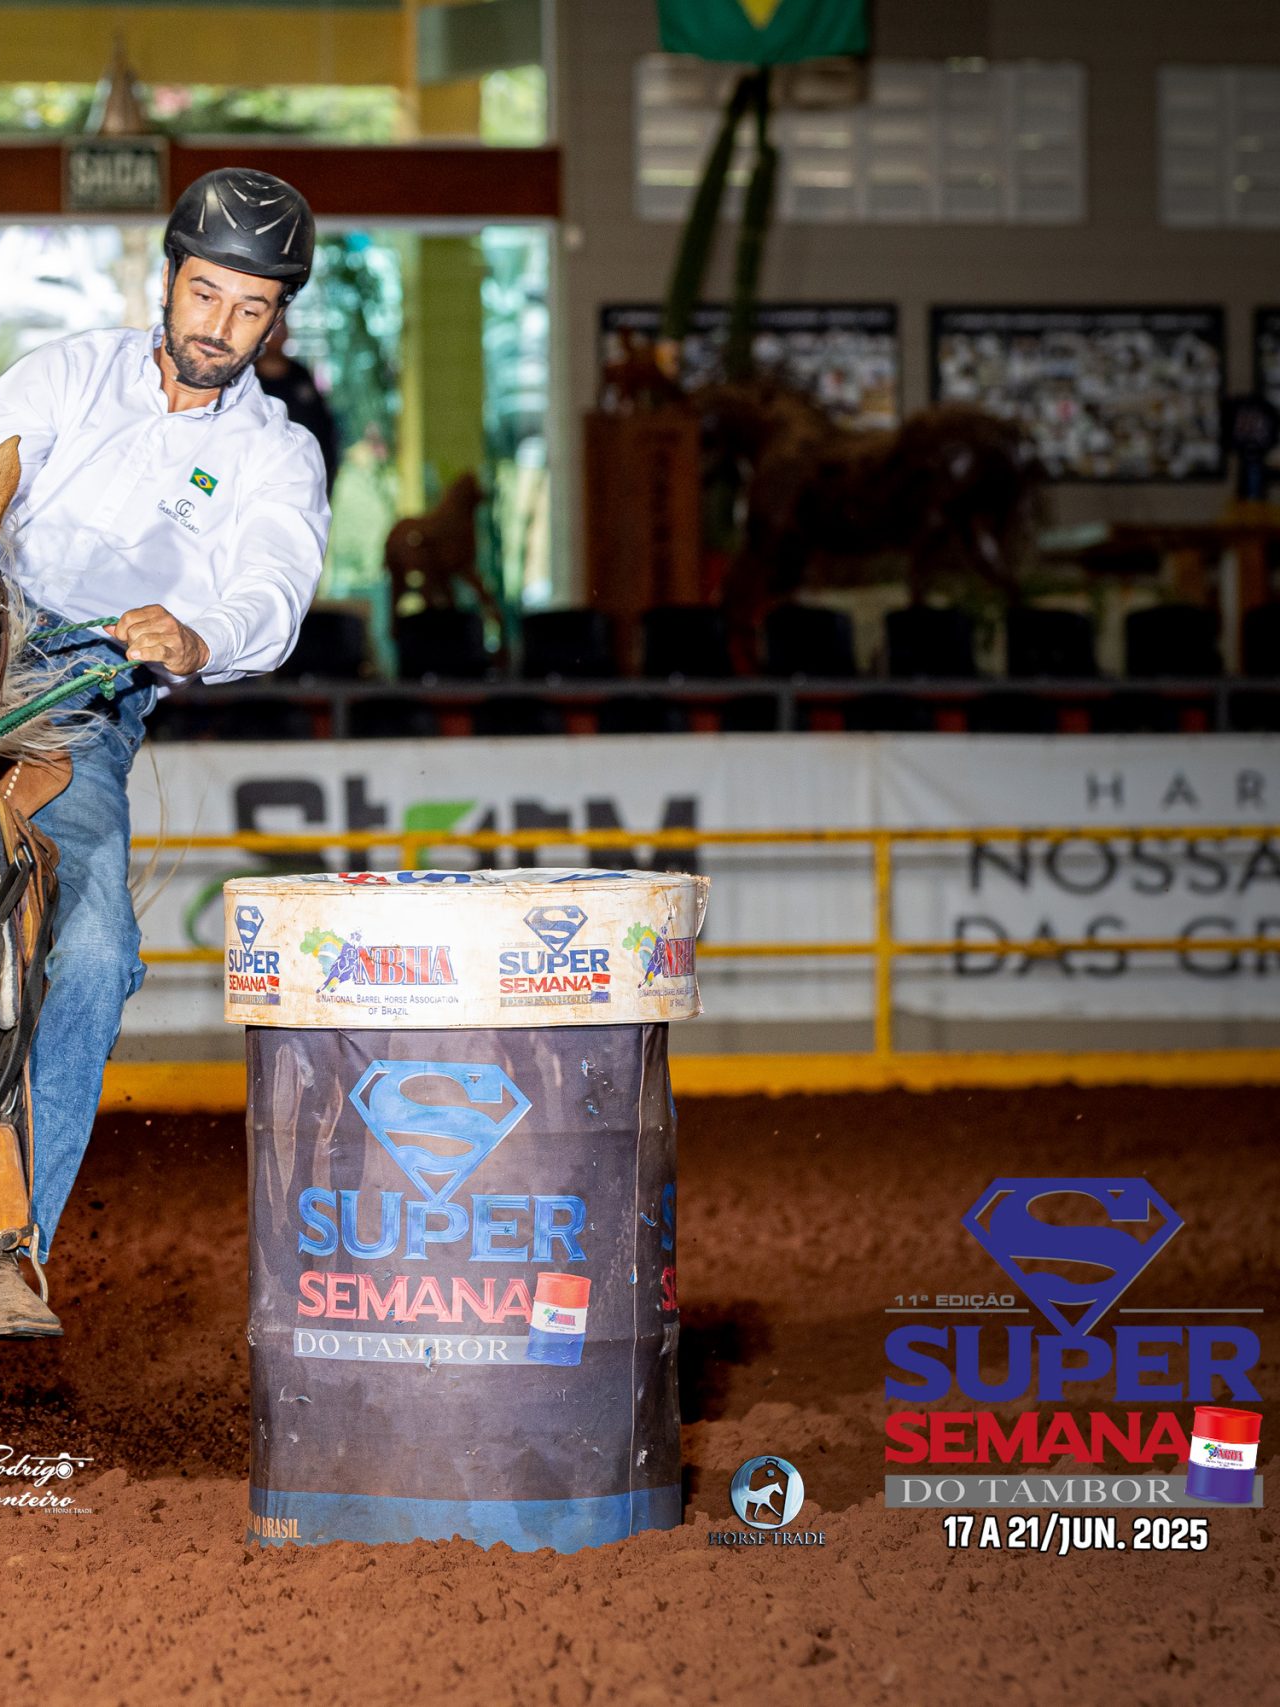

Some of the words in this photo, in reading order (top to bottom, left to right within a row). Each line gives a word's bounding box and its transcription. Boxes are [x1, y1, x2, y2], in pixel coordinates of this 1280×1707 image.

[179, 518, 200, 535] CLARO
[953, 913, 1130, 979] DAS
[228, 949, 280, 974] SUPER
[354, 945, 459, 985] NBHA
[499, 948, 610, 975] SUPER
[228, 974, 267, 993] SEMANA
[499, 974, 592, 994] SEMANA
[321, 994, 354, 1004] NATIONAL
[356, 994, 382, 1004] BARREL
[384, 994, 408, 1004] HORSE
[409, 994, 459, 1004] ASSOCIATION
[381, 1006, 409, 1015] BRAZIL
[297, 1186, 588, 1263] SUPER
[297, 1270, 533, 1324] SEMANA
[296, 1331, 340, 1355] DO
[348, 1334, 510, 1362] TAMBOR
[262, 1516, 301, 1538] BRASIL
